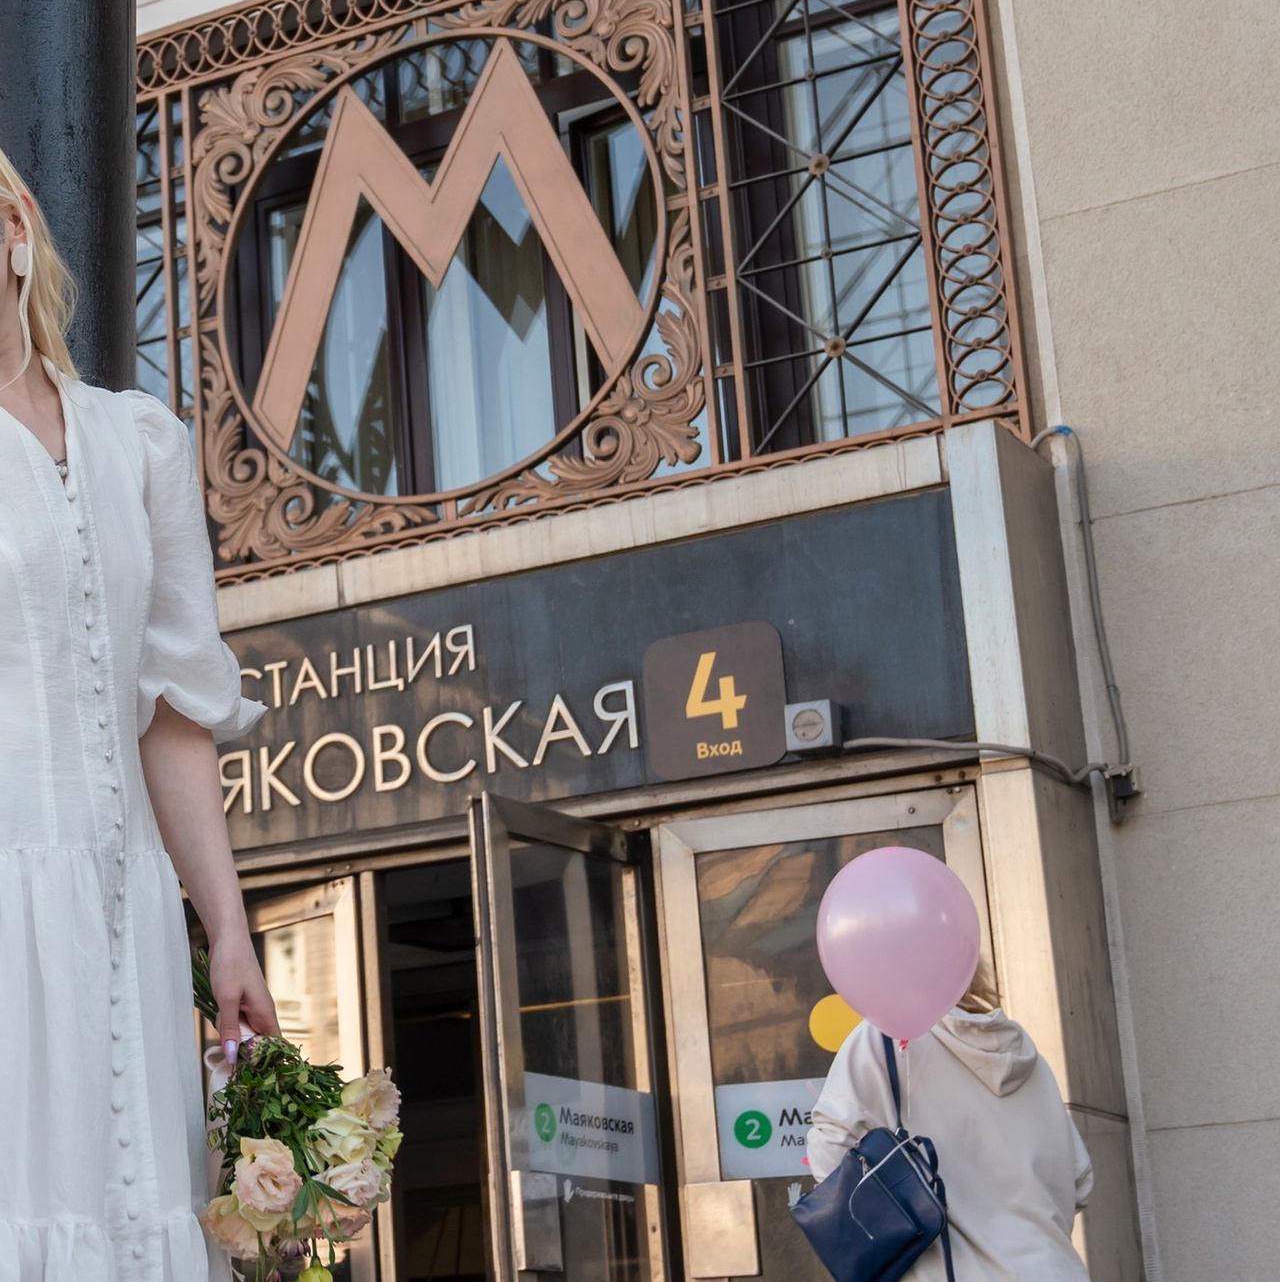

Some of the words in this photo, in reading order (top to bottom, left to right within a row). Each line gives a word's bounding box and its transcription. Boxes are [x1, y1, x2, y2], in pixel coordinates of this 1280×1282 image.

[686, 651, 748, 730] 4
[218, 679, 639, 815] ЯКОВСКАЯ
[696, 740, 743, 759] Вход
[540, 1111, 550, 1133] 2
[559, 1106, 635, 1134] Маяковская
[778, 1108, 814, 1127] Ма
[745, 1118, 762, 1141] 2
[560, 1132, 619, 1154] Mayakovskaya
[780, 1134, 807, 1148] Ma
